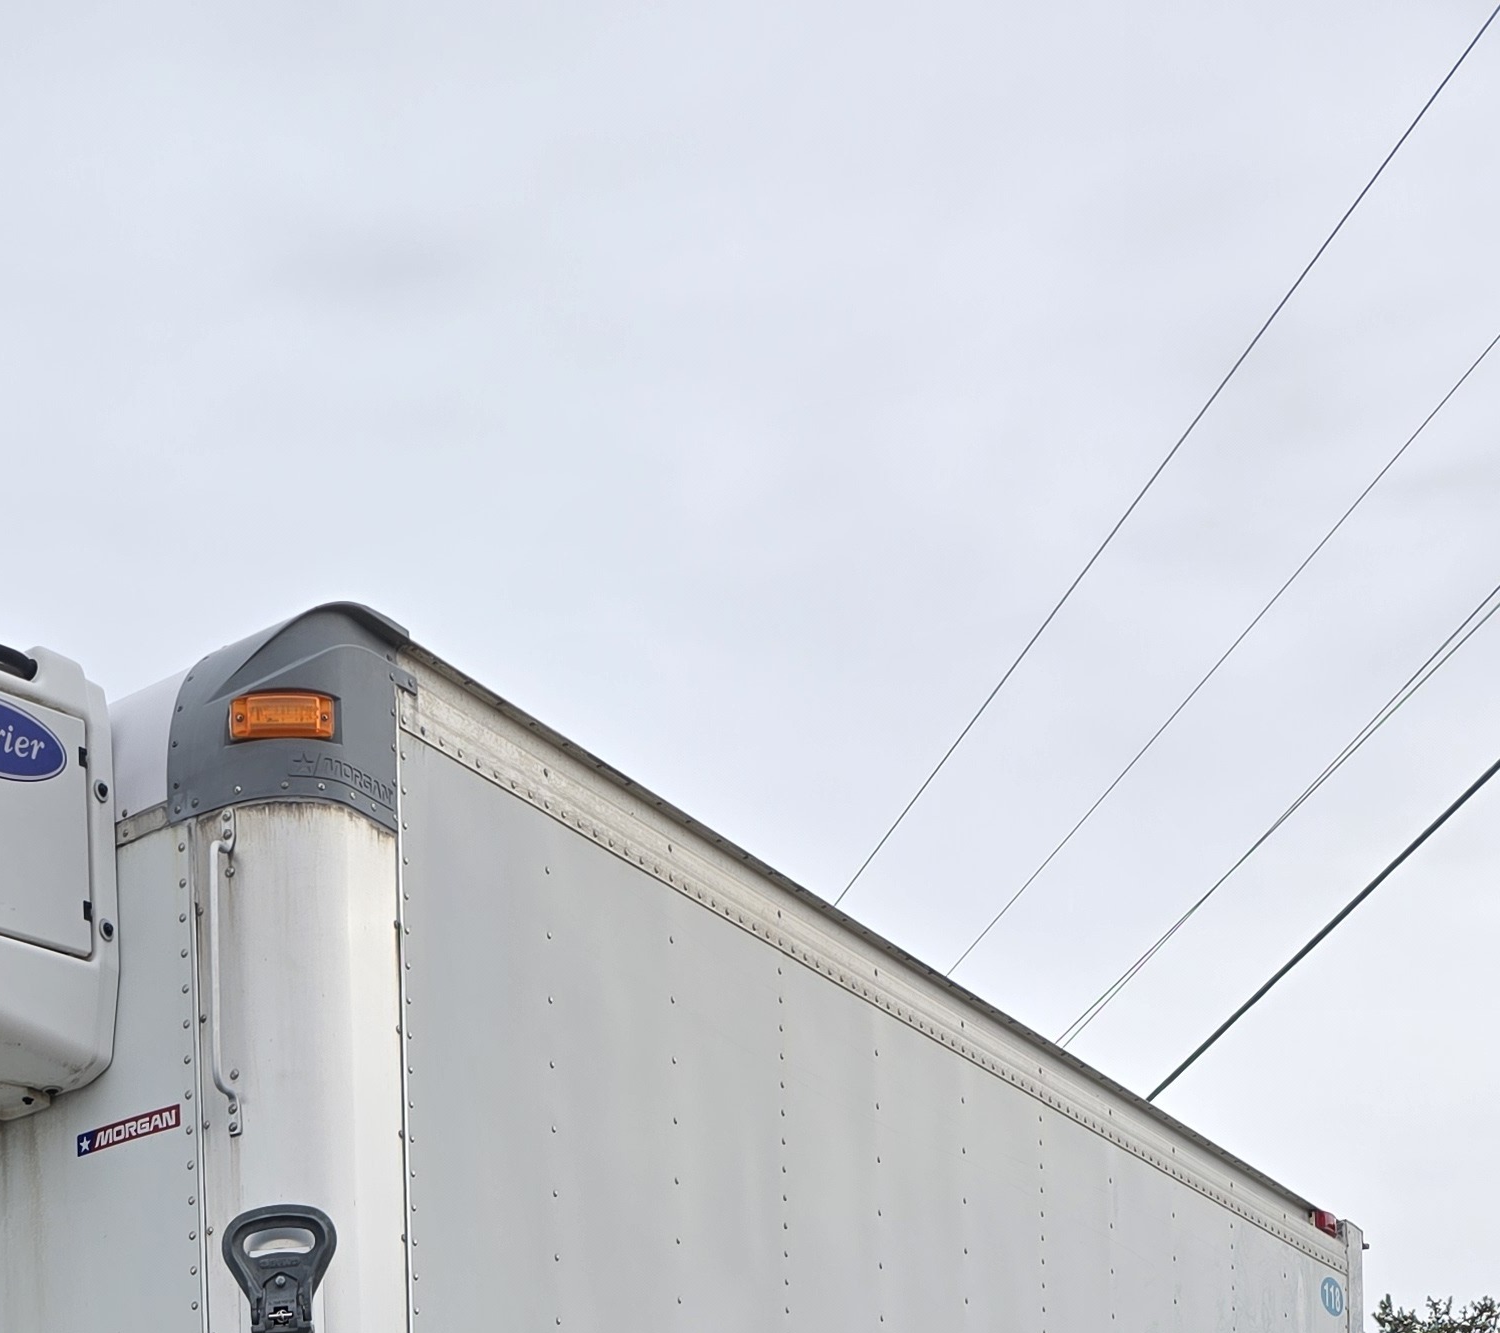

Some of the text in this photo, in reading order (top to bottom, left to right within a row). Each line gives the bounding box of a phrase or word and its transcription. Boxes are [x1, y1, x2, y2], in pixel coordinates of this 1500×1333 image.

[323, 757, 394, 804] MORGAN
[94, 1109, 176, 1148] MORGAN
[1323, 1282, 1340, 1312] 118
